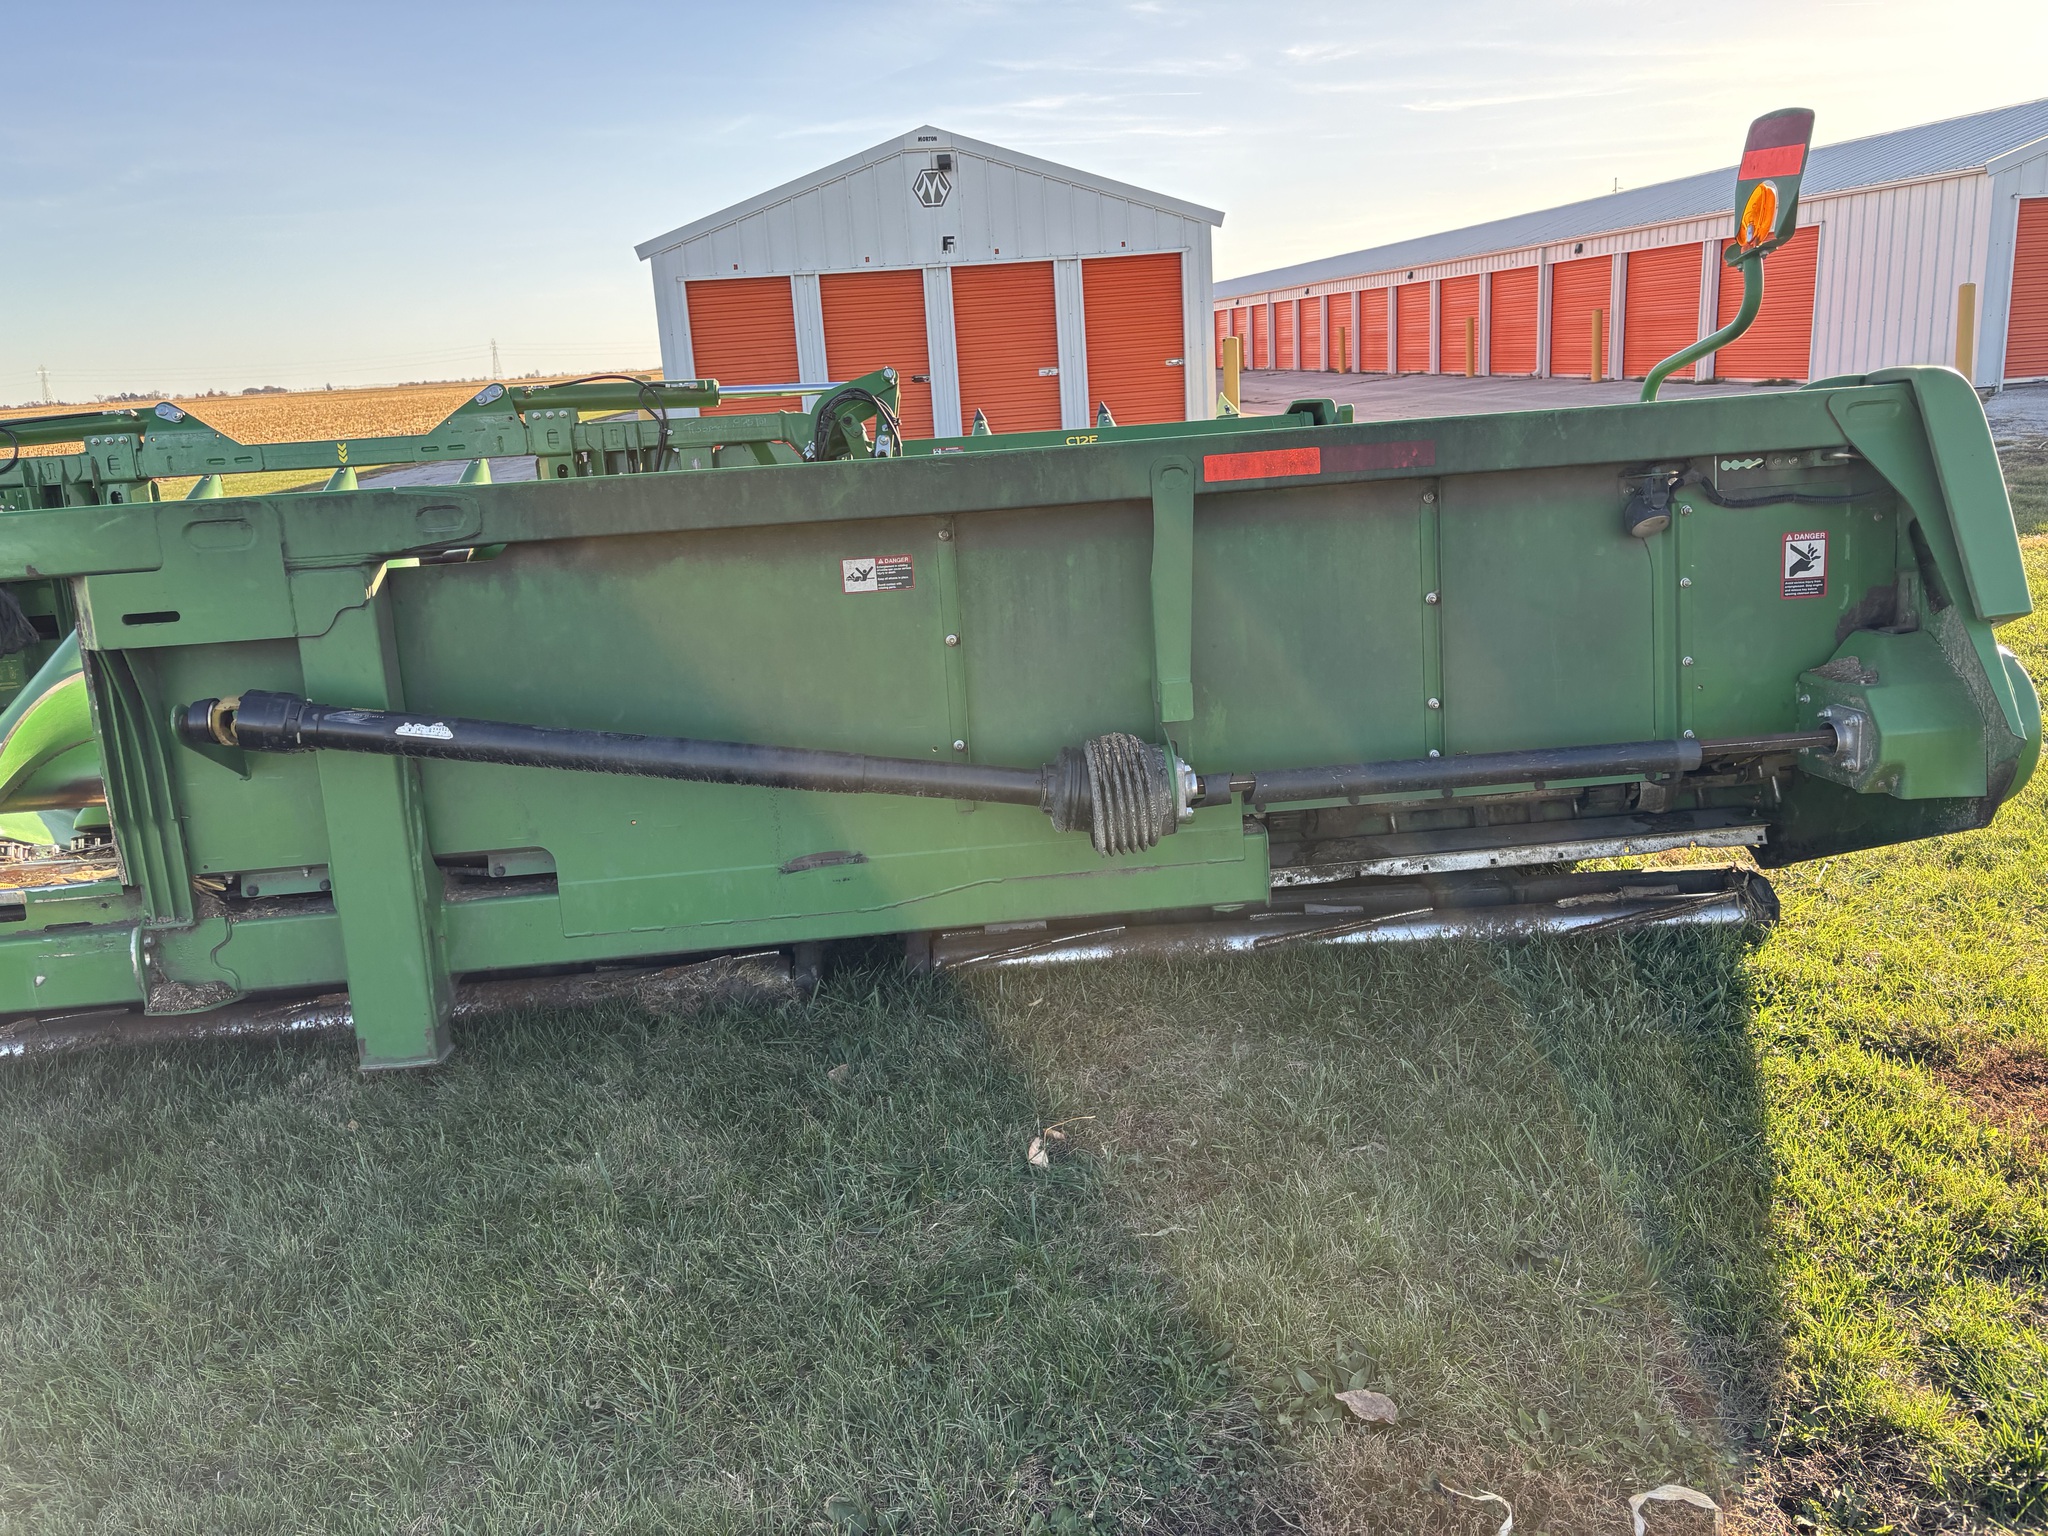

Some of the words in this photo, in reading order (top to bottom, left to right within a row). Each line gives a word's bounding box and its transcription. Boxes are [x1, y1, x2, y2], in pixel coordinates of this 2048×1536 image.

[943, 236, 955, 251] F
[1794, 532, 1826, 541] DANGER
[884, 556, 909, 565] DANGER
